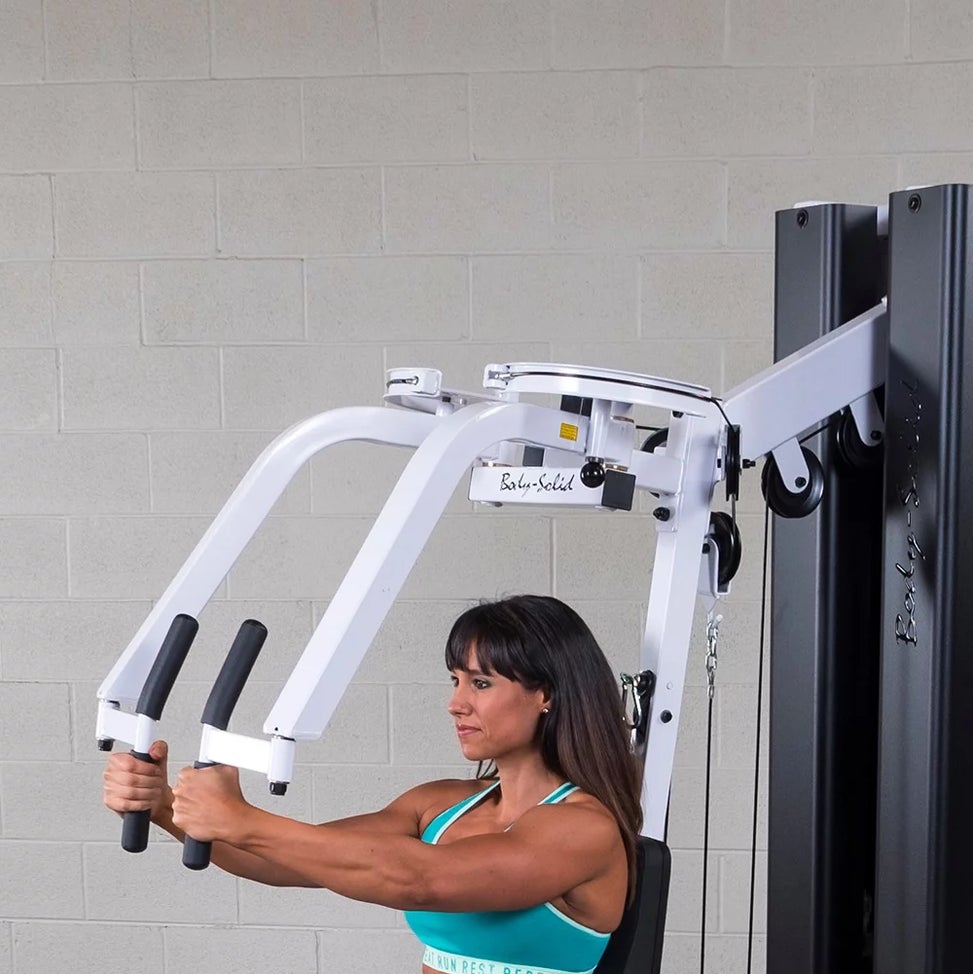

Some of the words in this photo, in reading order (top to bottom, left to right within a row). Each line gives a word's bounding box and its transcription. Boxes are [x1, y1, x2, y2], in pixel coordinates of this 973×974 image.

[500, 472, 575, 497] Body-Solid
[895, 380, 926, 647] Body-Sid
[437, 954, 457, 972] RUN
